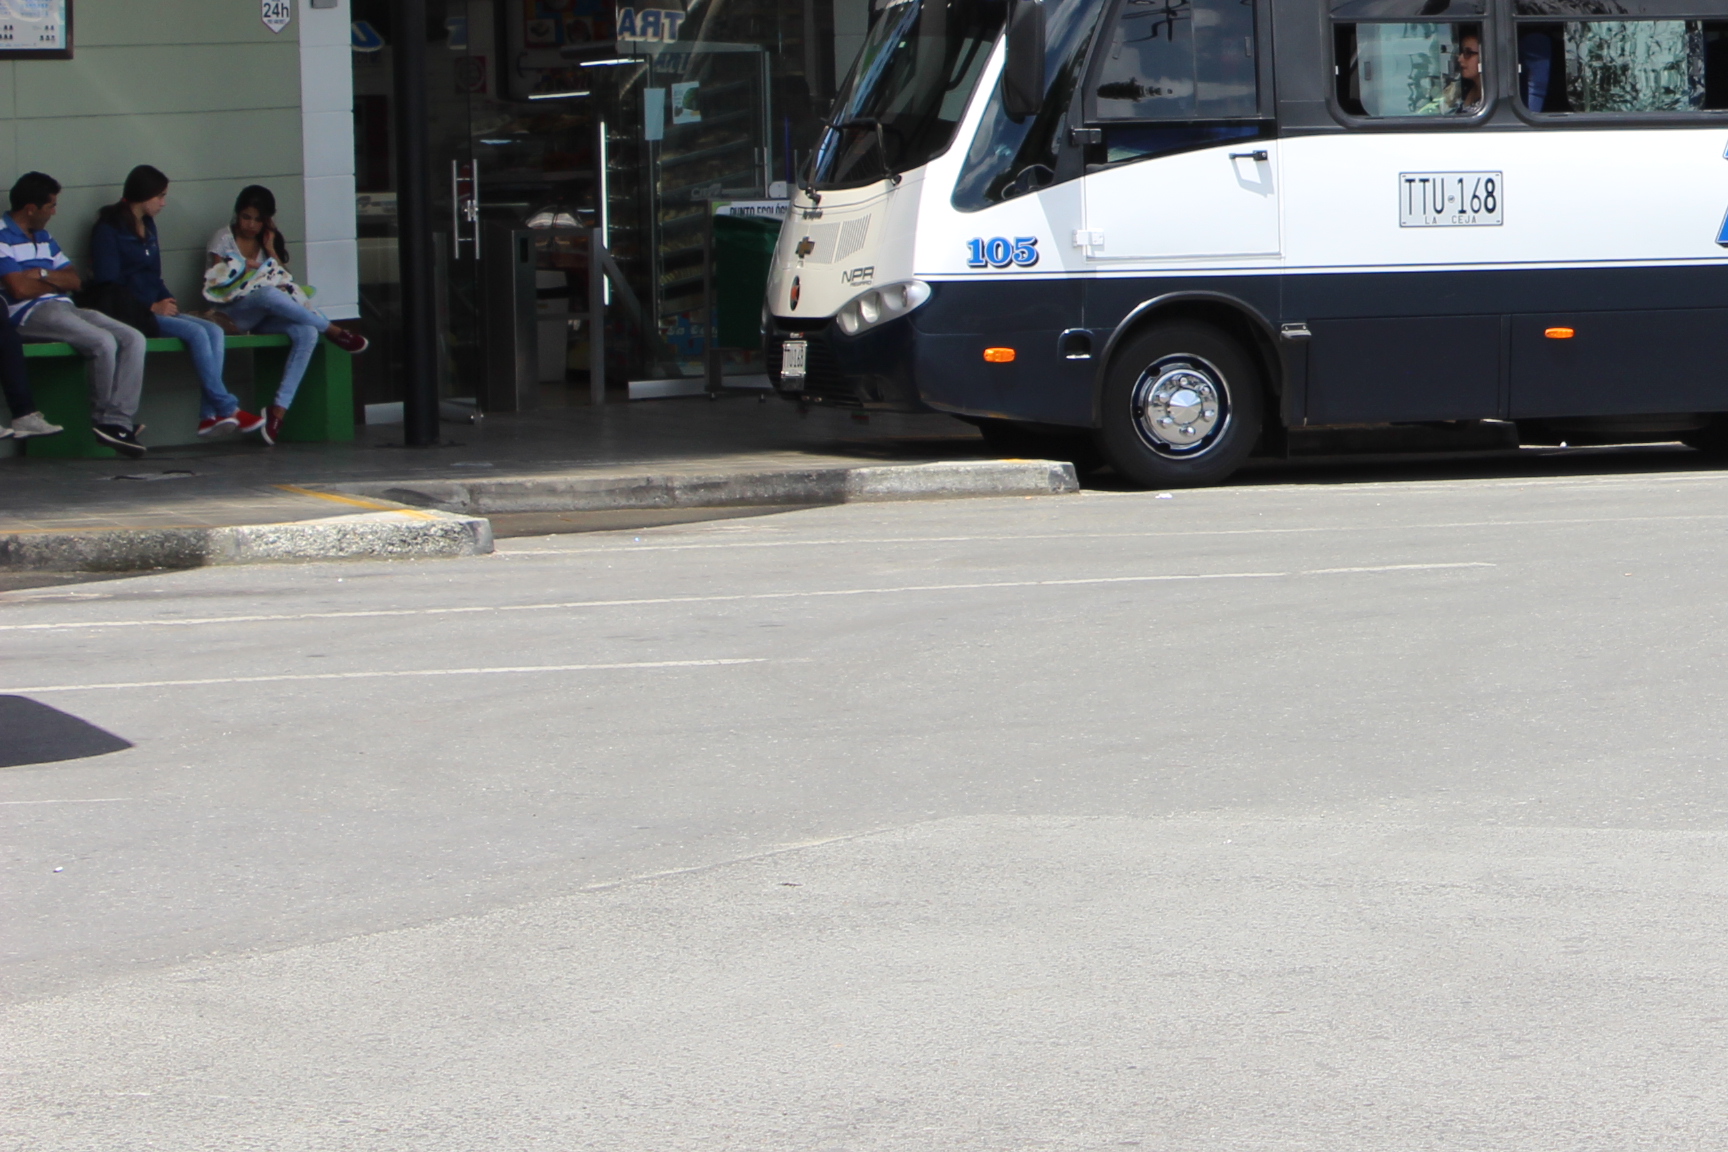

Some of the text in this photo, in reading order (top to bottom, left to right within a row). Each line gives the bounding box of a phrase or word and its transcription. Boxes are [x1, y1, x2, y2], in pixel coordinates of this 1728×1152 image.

[263, 2, 289, 18] 24h
[1425, 215, 1476, 225] LA CEJA
[966, 236, 1040, 269] 105
[841, 265, 875, 284] NPR
